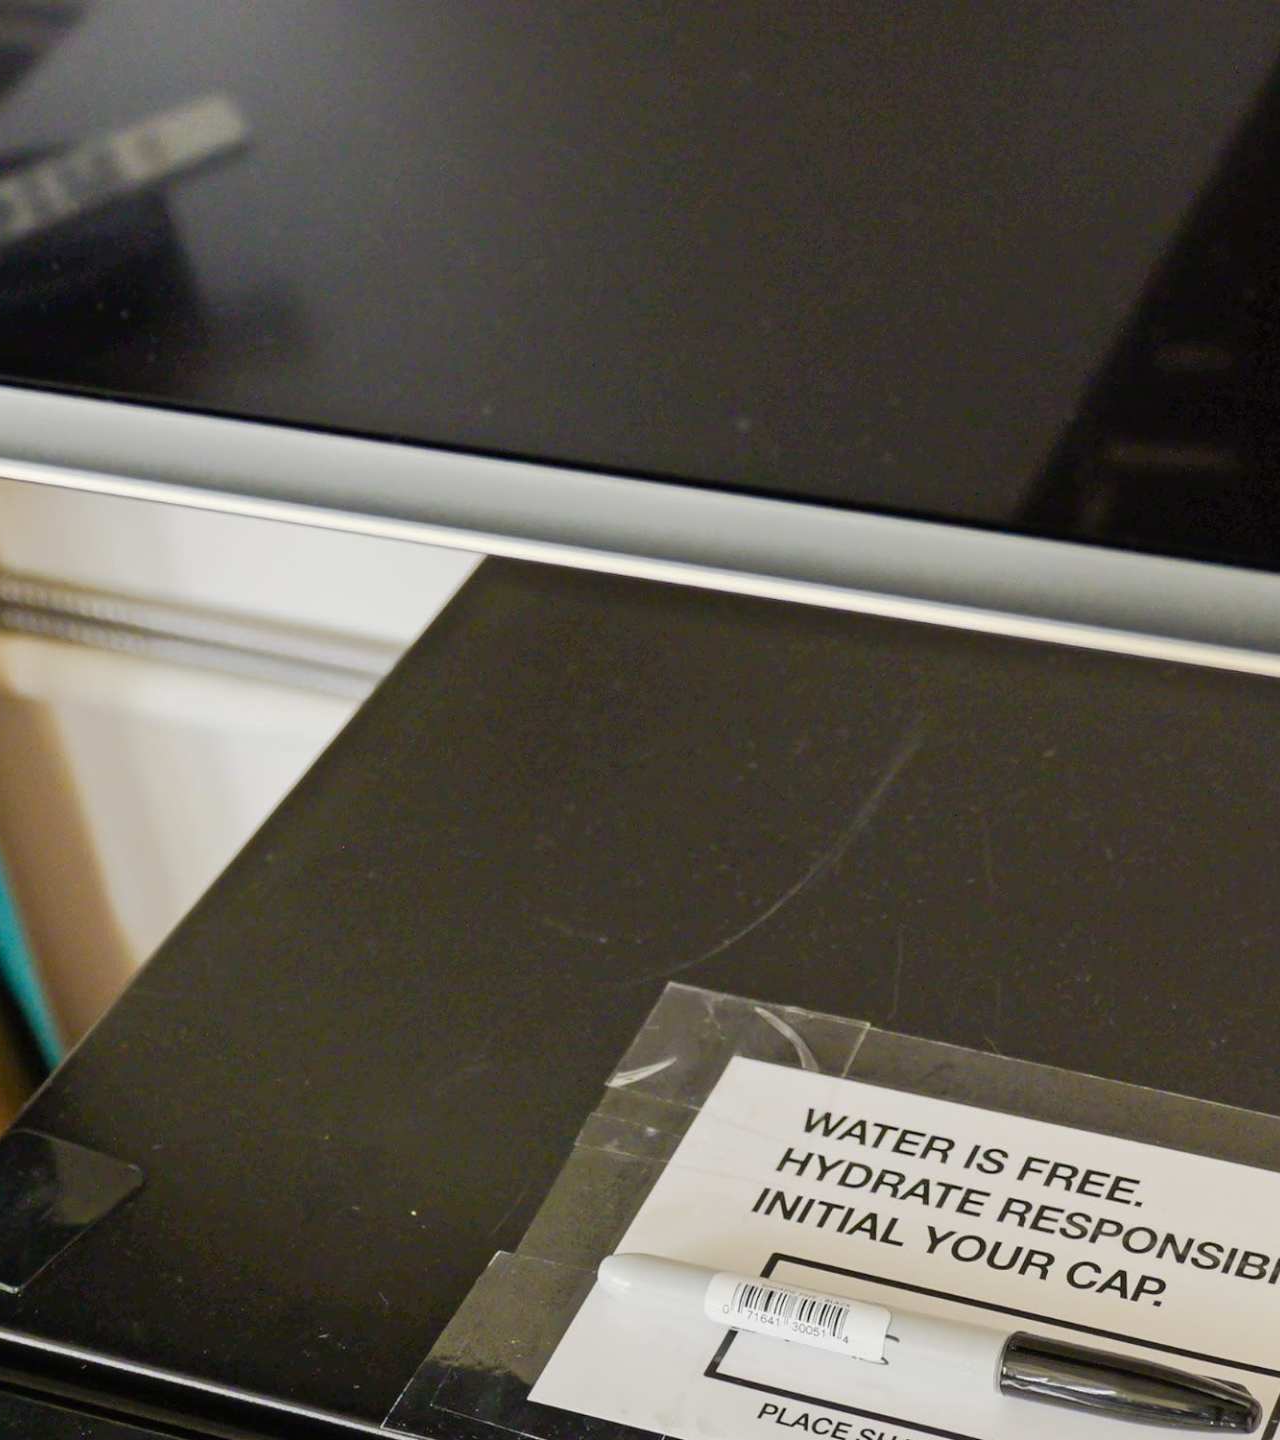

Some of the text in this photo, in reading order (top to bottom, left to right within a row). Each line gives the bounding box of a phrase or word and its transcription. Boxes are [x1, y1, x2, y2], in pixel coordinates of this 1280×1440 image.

[775, 1147, 991, 1218] HYDRATE
[803, 1107, 1144, 1208] WATER IS FREE.
[751, 1187, 1168, 1307] INITIAL YOUR CAP.
[722, 1303, 849, 1344] 0 71641 30051 4
